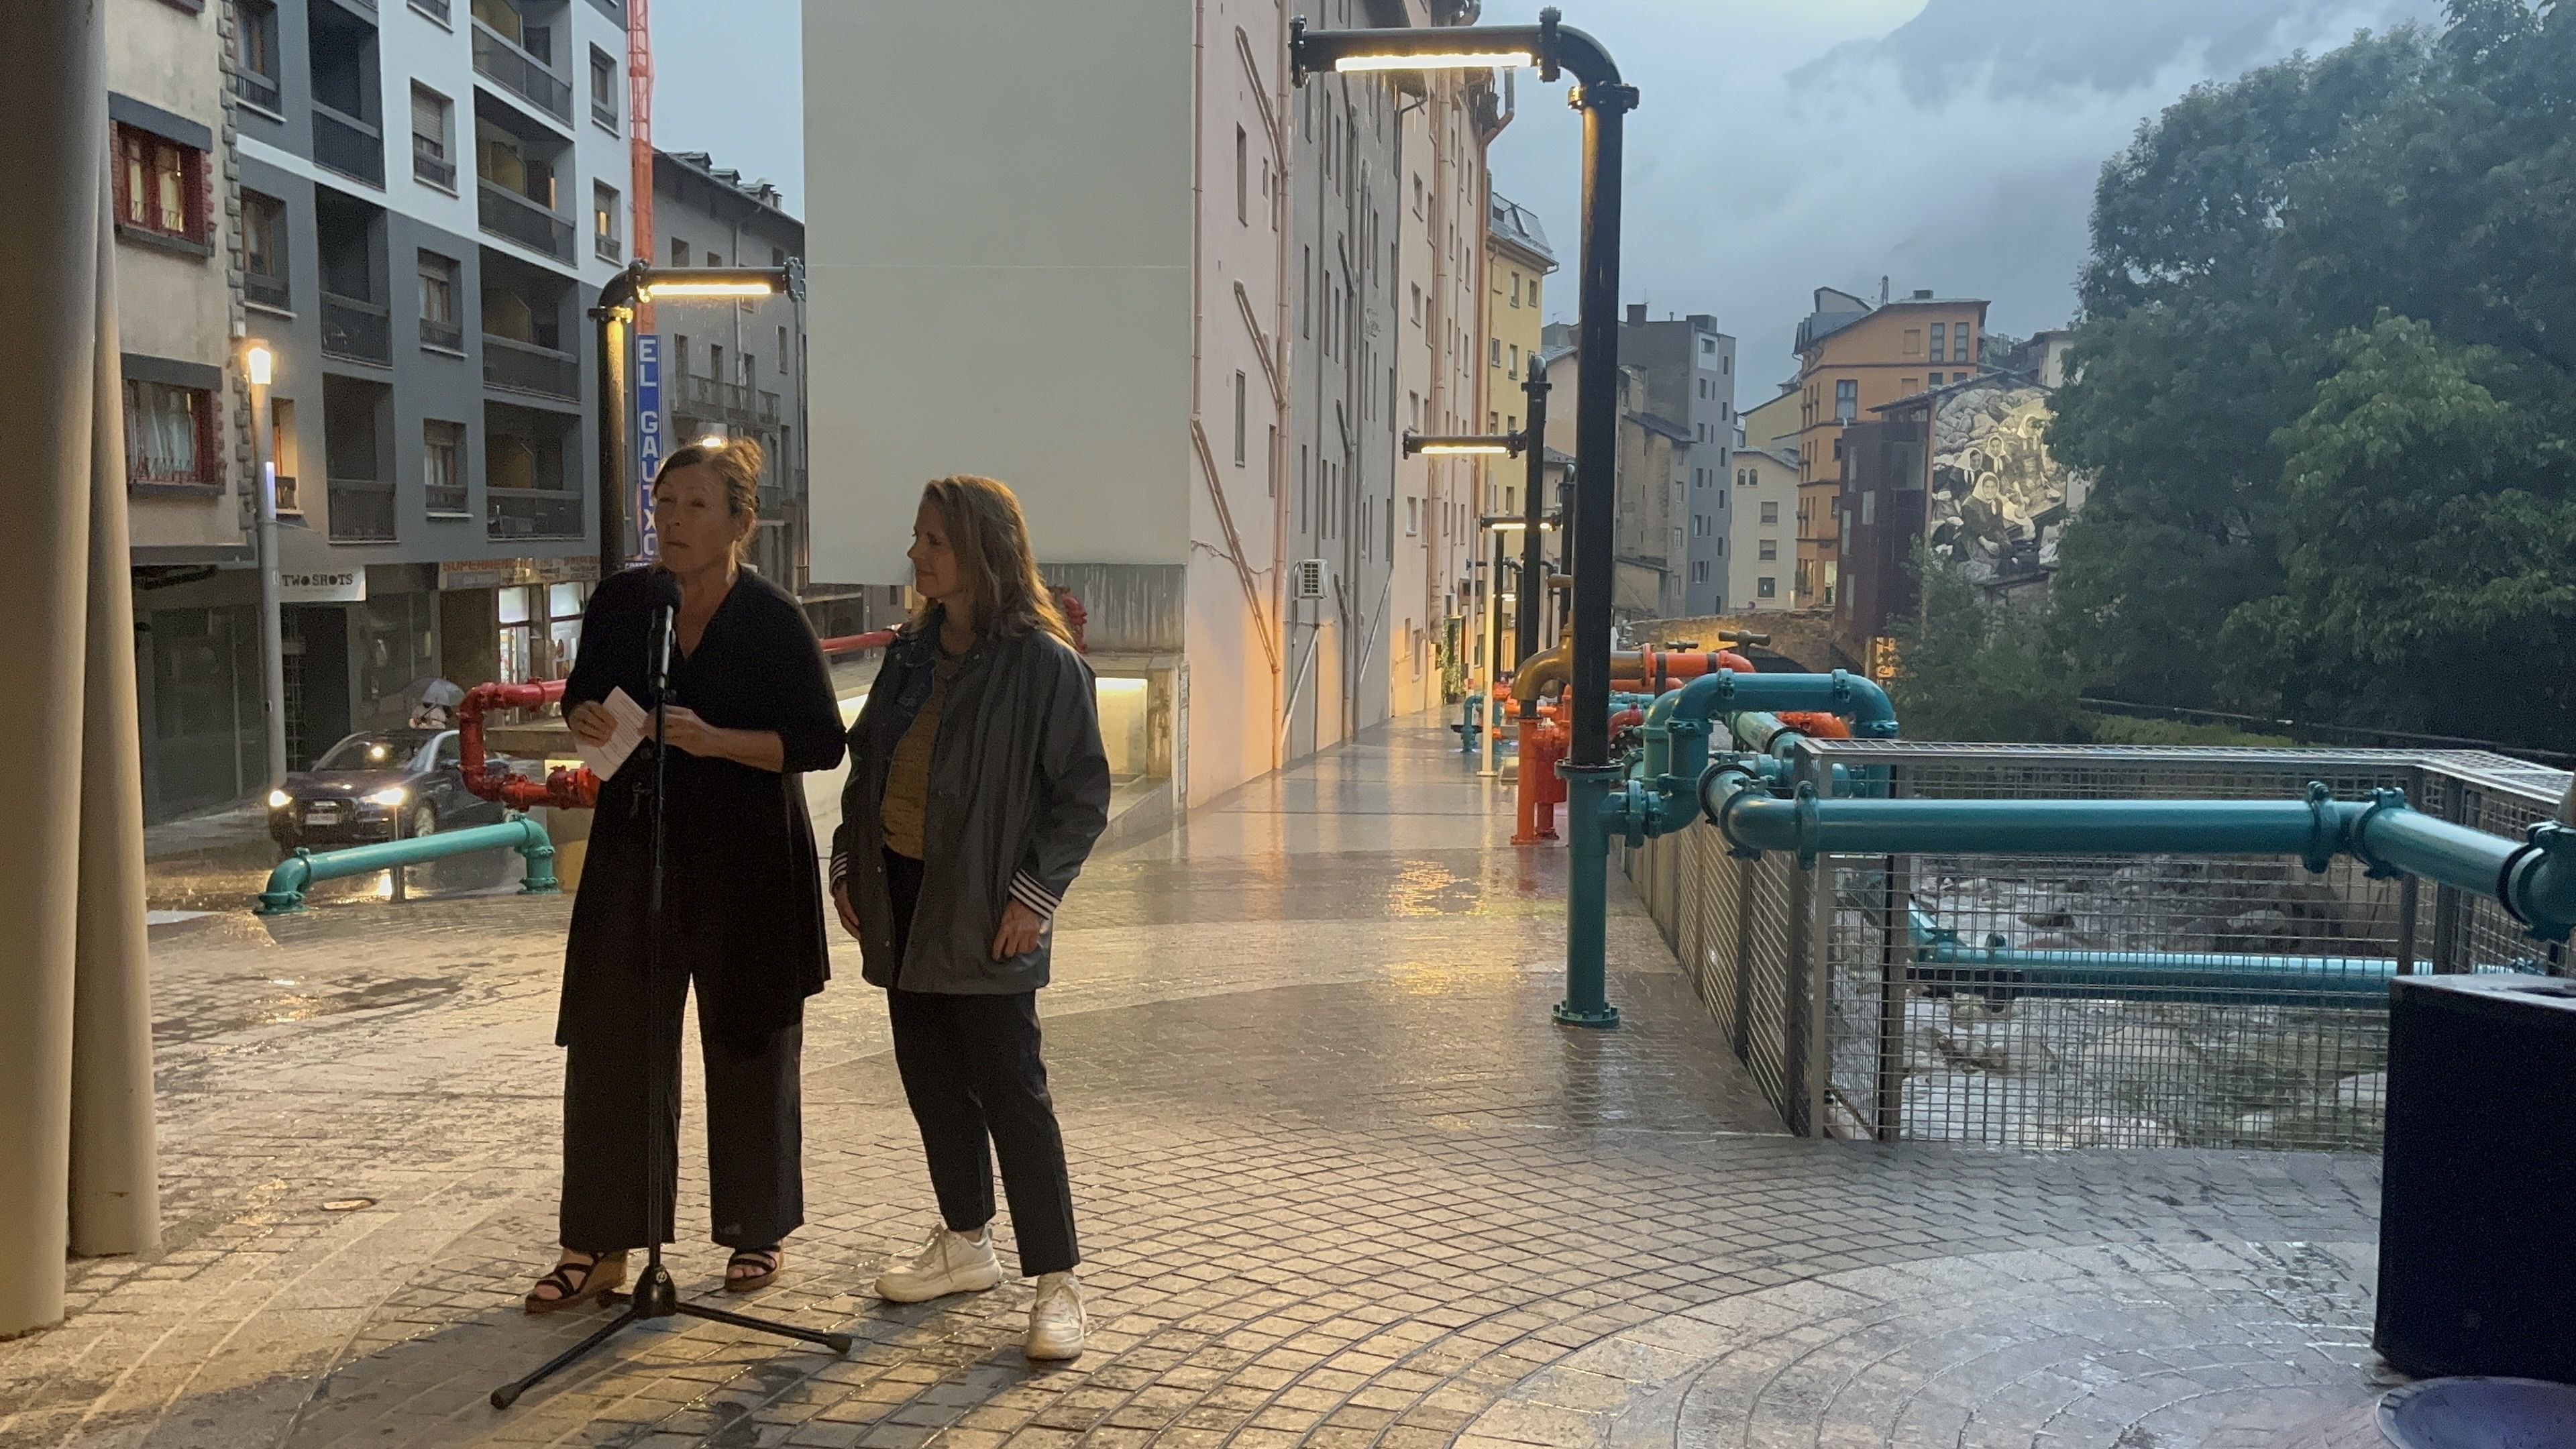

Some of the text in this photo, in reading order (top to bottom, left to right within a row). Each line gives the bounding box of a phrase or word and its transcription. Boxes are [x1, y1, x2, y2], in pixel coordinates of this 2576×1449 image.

[639, 339, 657, 387] EL
[282, 574, 354, 587] TWO SHOTS
